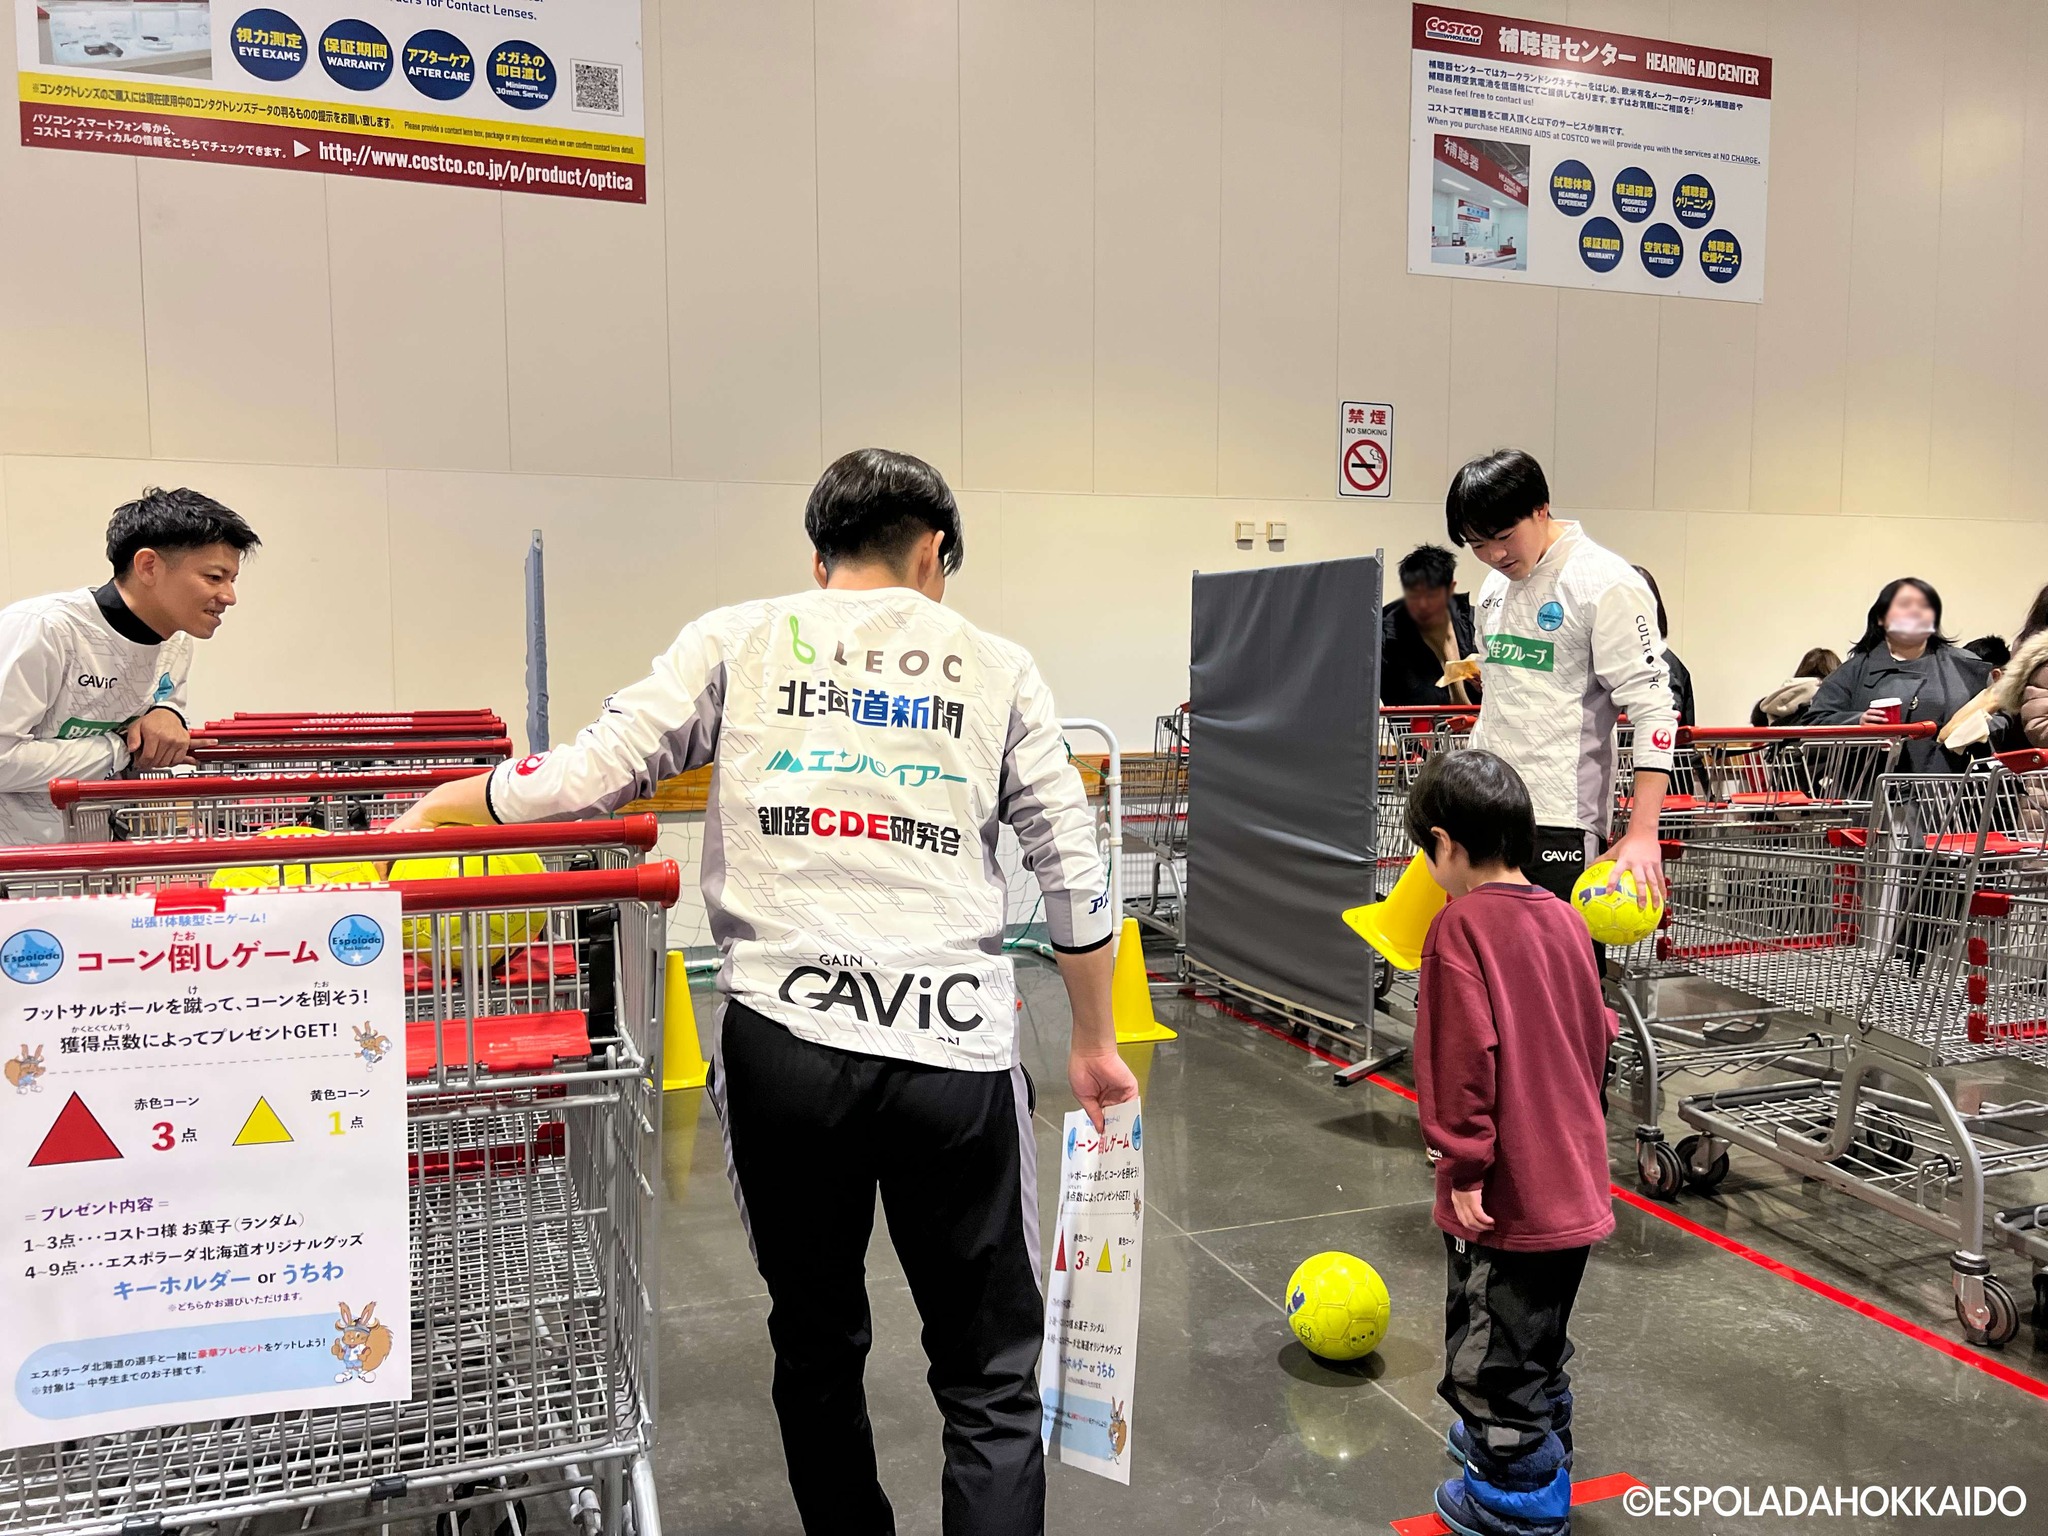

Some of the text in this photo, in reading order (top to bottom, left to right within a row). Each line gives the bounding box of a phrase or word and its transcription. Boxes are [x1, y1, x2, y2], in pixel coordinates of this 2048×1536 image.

[446, 0, 491, 14] Contact
[494, 4, 537, 20] Lenses.
[1427, 18, 1482, 37] COSTCO
[236, 26, 302, 50] 視力測定
[1444, 34, 1480, 43] WHOLESALE
[1499, 26, 1636, 66] 補聴器センター
[239, 47, 301, 62] EYE EXAMS
[324, 37, 388, 60] 保証期間
[326, 56, 386, 72] WARRANTY
[407, 48, 471, 68] アフターケア
[496, 52, 545, 68] メガネの
[408, 66, 471, 82] AFTER CARE
[496, 64, 547, 82] 即日渡し
[1646, 51, 1759, 86] HEARING AID CENTER
[496, 87, 549, 100] 30min. Service
[505, 80, 538, 92] Minimum
[1428, 84, 1452, 96] Please
[1454, 88, 1468, 98] feel
[1470, 90, 1485, 100] free
[1496, 95, 1521, 104] contact
[1523, 98, 1534, 106] us!
[33, 126, 71, 139] コストコ
[405, 121, 420, 130] Please
[1427, 116, 1448, 126] When
[1450, 119, 1462, 128] you
[1464, 121, 1498, 132] purchase
[1500, 126, 1532, 136] HEARING
[1534, 130, 1551, 139] AIDS
[1552, 132, 1560, 140] at
[1561, 132, 1590, 144] COSTCO
[1602, 139, 1615, 147] will
[1616, 141, 1642, 150] provide
[1643, 144, 1655, 152] you
[1656, 144, 1670, 154] with
[1672, 147, 1683, 155] the
[1684, 150, 1712, 160] services
[1712, 152, 1720, 160] at
[1720, 153, 1730, 162] NO
[1731, 154, 1761, 165] CHARGE.
[1444, 137, 1480, 172] 補聴器
[319, 141, 634, 192] http://www.costco.co.jp/p/product/optica
[1554, 176, 1592, 192] 試聴体験
[1616, 183, 1654, 198] 経過確認
[1681, 184, 1708, 198] 補聴器
[1558, 199, 1588, 208] EXPERIENCE
[1621, 198, 1648, 206] PROGRESS
[1622, 206, 1638, 214] CHECK
[1675, 196, 1714, 211] クリーニング
[1682, 210, 1707, 218] CLEANING
[1582, 236, 1620, 252] 保証期間
[1644, 242, 1680, 256] 空気電池
[1708, 240, 1734, 254] 補聴器
[1586, 252, 1616, 260] WARRANTY
[1648, 256, 1674, 265] BATTERIES
[1702, 251, 1739, 266] 乾燥ケース
[1719, 266, 1732, 274] CASE
[1357, 428, 1388, 436] SMOKING
[834, 640, 963, 683] LEOC
[777, 678, 965, 740] 北海道新聞
[807, 748, 968, 788] エンパイアー
[758, 806, 962, 856] 釧路CDE研究会
[1542, 850, 1582, 862] GAViC
[131, 913, 267, 929] 出張!体験型ミニゲーム!
[172, 931, 196, 942] たお
[78, 940, 320, 974] コーン倒しゲーム
[820, 954, 862, 968] GAIN
[188, 986, 198, 995] け
[24, 989, 368, 1022] フットサルボールを蹴って、コーンを倒そう!
[778, 966, 984, 1032] GAViC
[71, 1023, 130, 1034] かくとくてんすう
[60, 1022, 338, 1054] 獲得点数によってプレゼントGET!
[134, 1096, 200, 1110] 赤色コーン
[310, 1088, 370, 1102] 黄色コーン
[328, 1111, 364, 1136] 1 点
[152, 1121, 198, 1151] 3 点
[41, 1196, 154, 1222] プレゼント内容
[1075, 1250, 1084, 1270] 3
[113, 1261, 344, 1300] キーホルダー or うちわ
[168, 1290, 303, 1313] ※どちらかお選びいただけます。
[1096, 1361, 1116, 1379] うちわ
